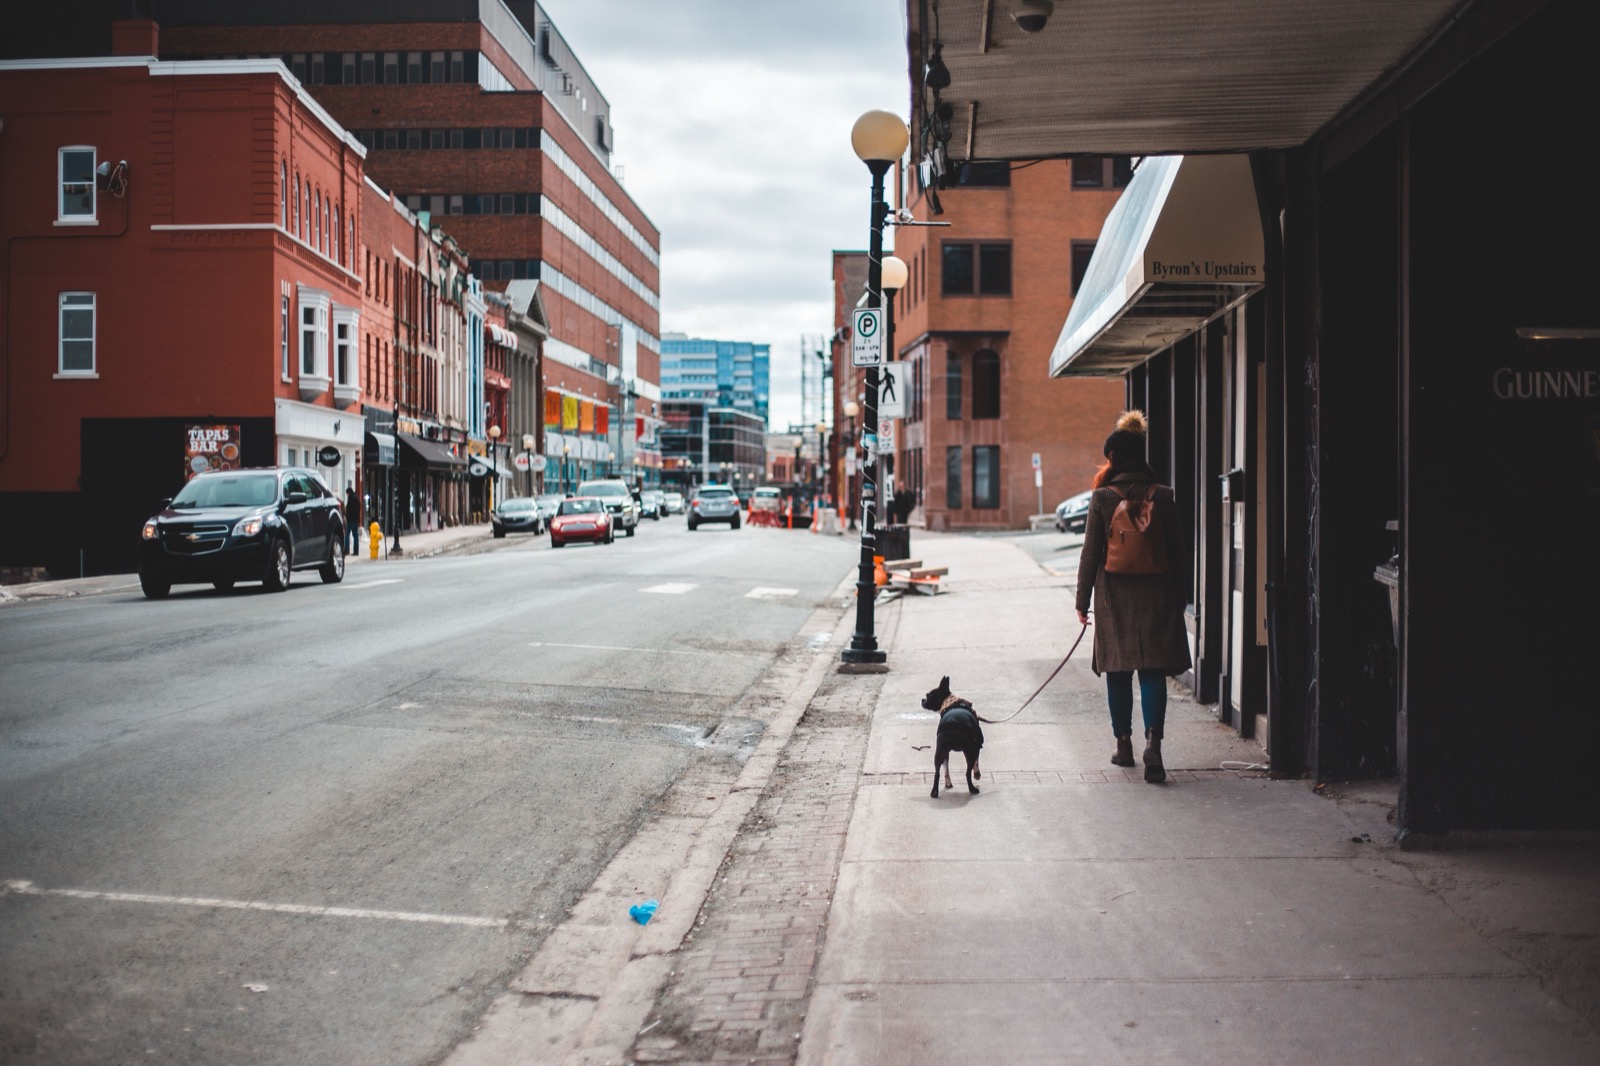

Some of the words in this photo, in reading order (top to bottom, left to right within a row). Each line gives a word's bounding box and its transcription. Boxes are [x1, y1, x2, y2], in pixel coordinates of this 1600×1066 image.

[1152, 261, 1200, 279] Byron's
[1204, 261, 1256, 279] Upstairs
[863, 317, 873, 333] P
[1492, 367, 1600, 399] GUINNE
[188, 429, 229, 441] TAPAS
[190, 441, 218, 452] BAR
